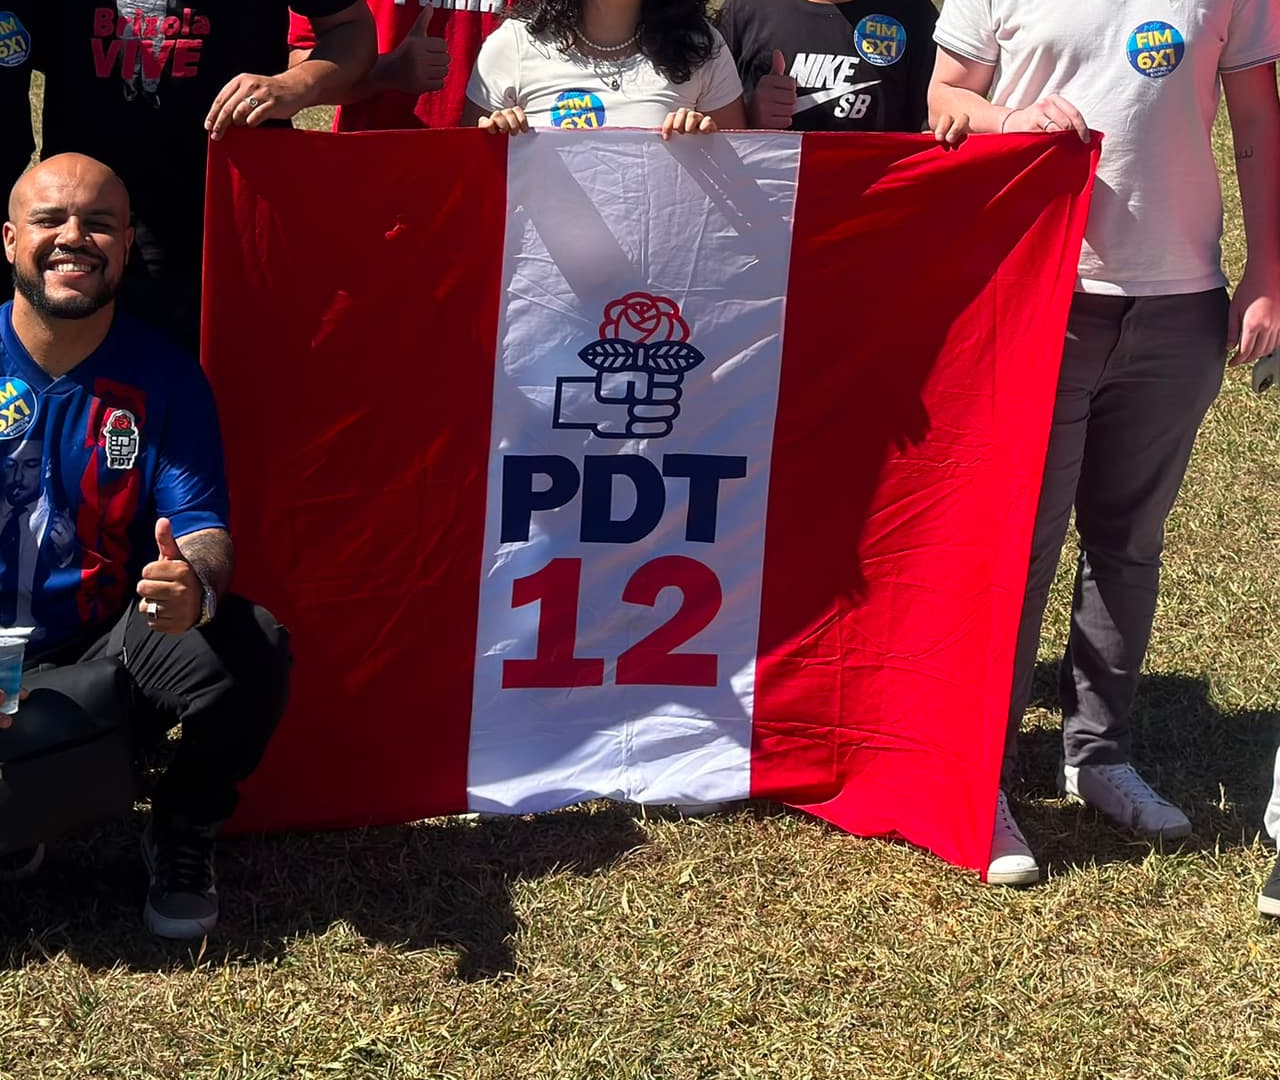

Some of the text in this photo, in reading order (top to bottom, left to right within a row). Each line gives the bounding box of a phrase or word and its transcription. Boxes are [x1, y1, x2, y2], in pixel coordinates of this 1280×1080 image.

[866, 21, 897, 38] FIM
[1136, 29, 1173, 49] FIM
[91, 39, 203, 79] VIVE
[789, 53, 860, 89] NIKE
[834, 93, 872, 119] SB
[111, 457, 132, 467] PDT
[500, 453, 747, 544] PDT
[501, 555, 723, 689] 12
